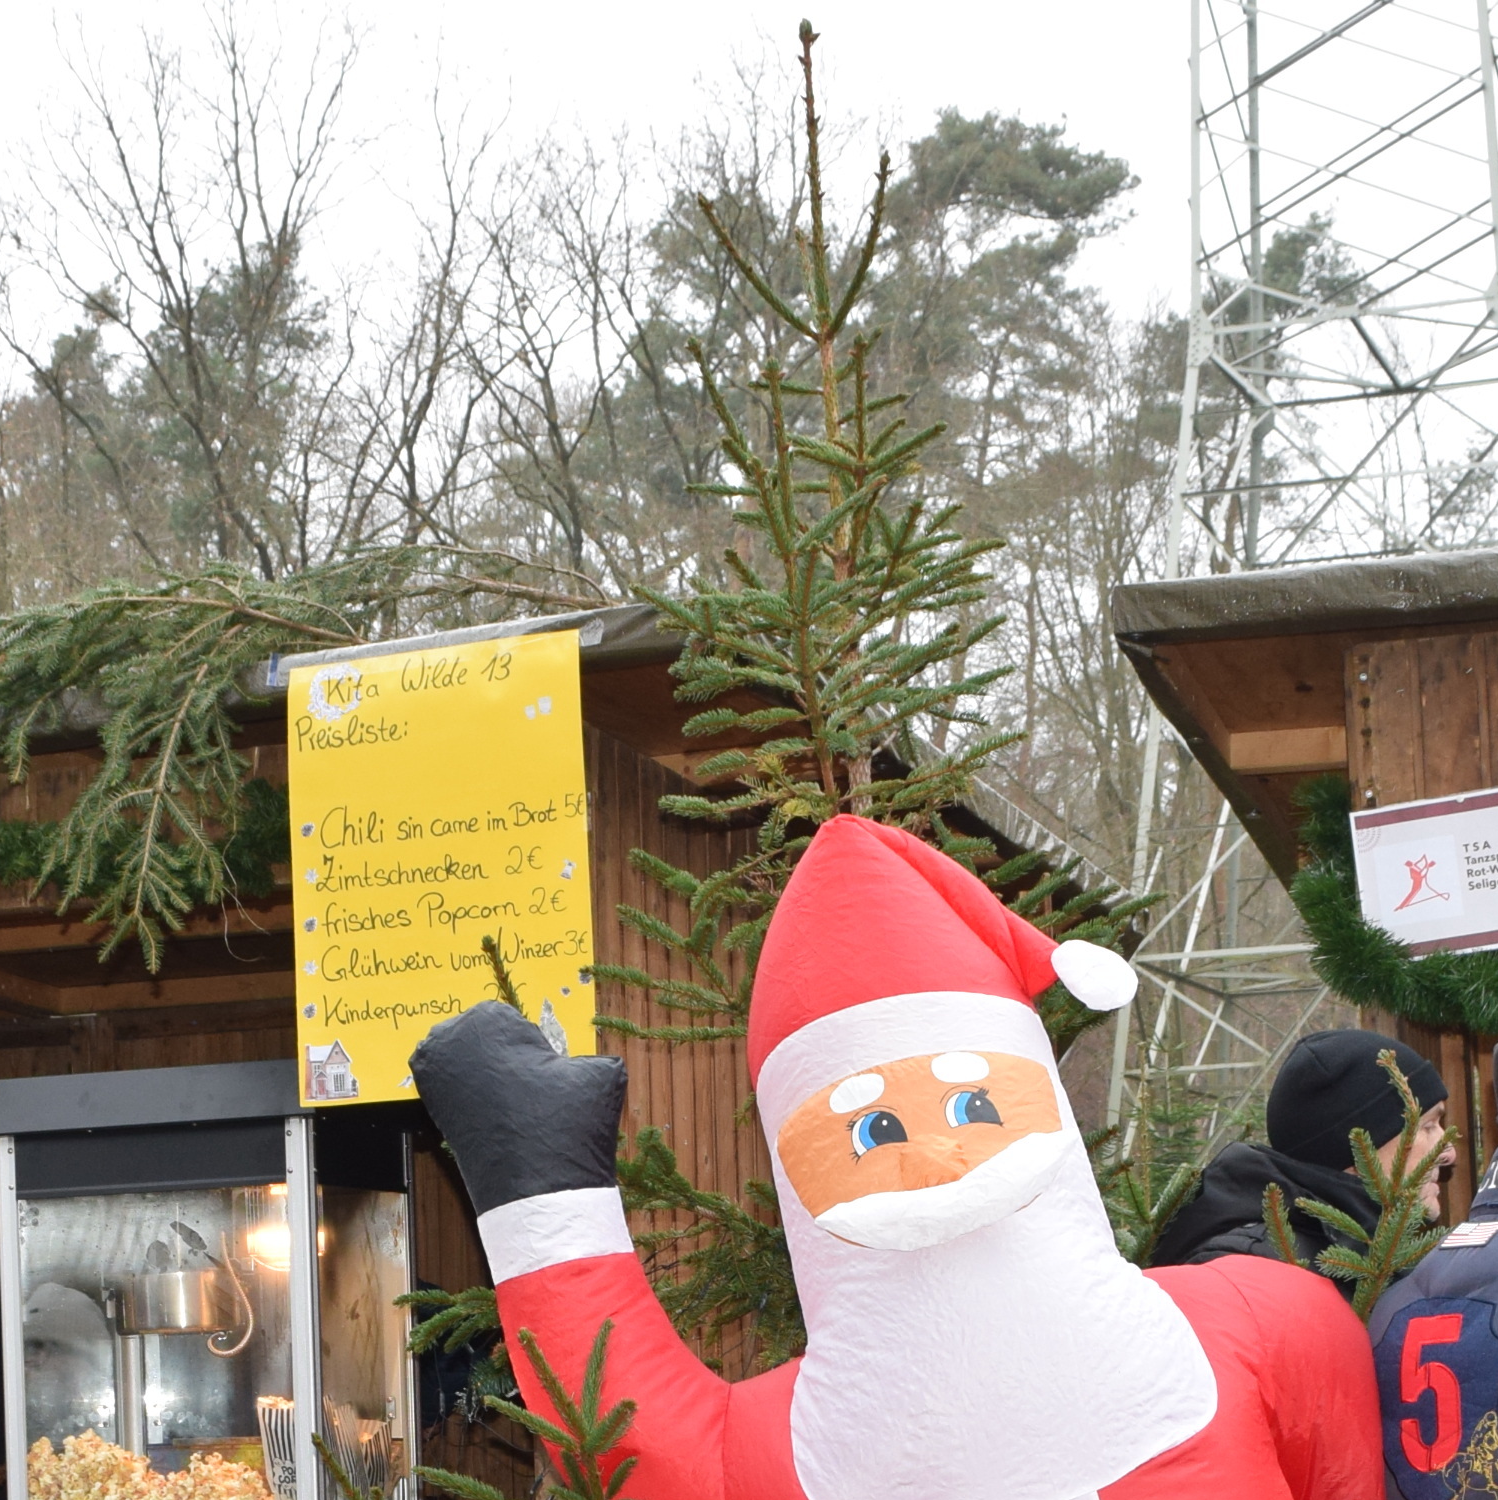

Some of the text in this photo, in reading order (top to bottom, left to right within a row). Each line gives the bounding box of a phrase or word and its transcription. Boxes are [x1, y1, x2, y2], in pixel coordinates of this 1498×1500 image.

[325, 651, 512, 703] Kita Wilde 13
[294, 714, 409, 753] Preisliste:
[319, 806, 385, 850] Chili
[396, 818, 425, 841] sin
[486, 812, 509, 833] im
[508, 797, 558, 828] Brot
[315, 853, 490, 893] Zimtschnecken
[321, 901, 412, 938] frisches
[416, 891, 522, 935] Popcorn
[320, 945, 443, 983] Glühwein
[448, 949, 491, 974] vom
[322, 993, 465, 1030] Kinderpunsch
[1400, 1312, 1463, 1473] 5
